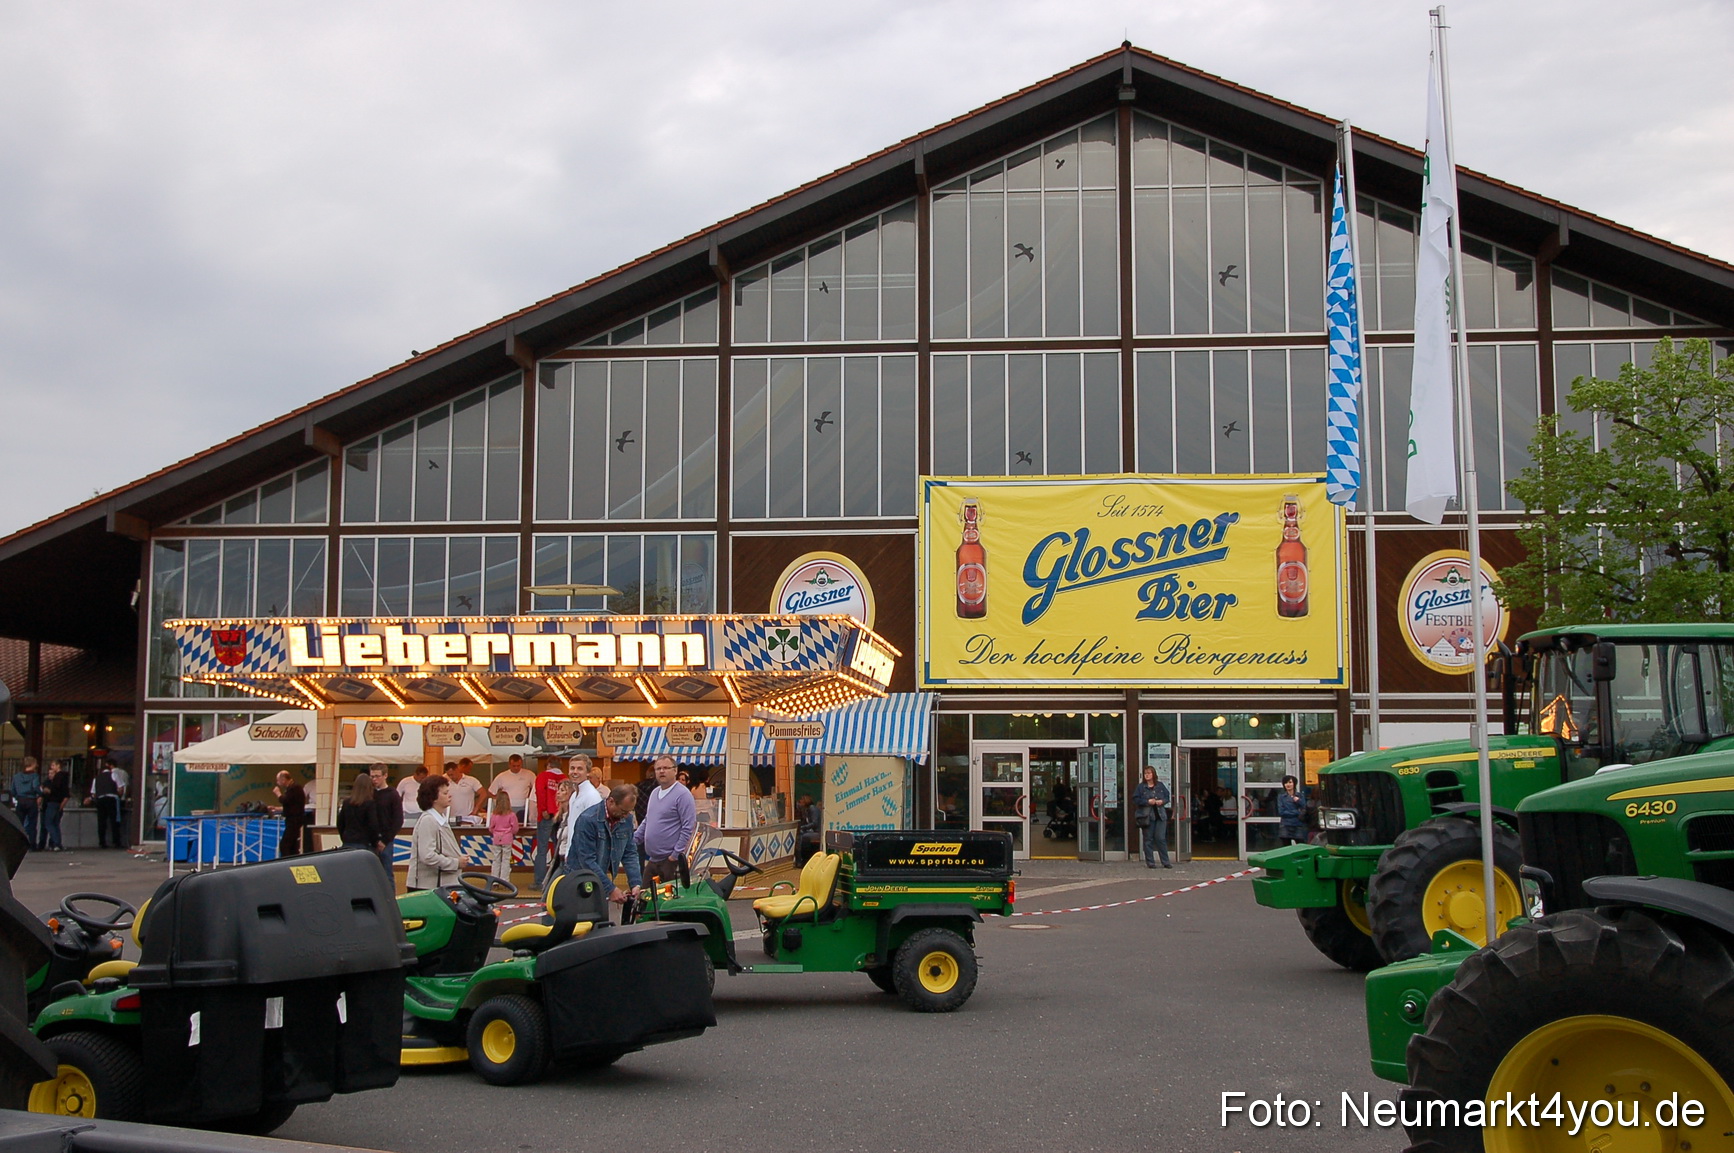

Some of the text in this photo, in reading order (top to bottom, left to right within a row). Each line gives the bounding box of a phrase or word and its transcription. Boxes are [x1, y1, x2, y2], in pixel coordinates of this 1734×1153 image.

[1097, 494, 1165, 518] Seit 1574
[1022, 511, 1241, 625] Glossner
[785, 585, 855, 614] Glossner
[1135, 572, 1239, 622] Bier
[1414, 585, 1488, 621] Glossnr
[1425, 613, 1484, 627] FESTBIE
[288, 624, 706, 667] Liebermann
[958, 633, 1309, 676] Der hochfeine Biergenuss
[1516, 750, 1542, 758] DEERE
[1398, 766, 1420, 776] 6830
[834, 781, 863, 803] Einmal
[845, 792, 871, 811] immer
[1625, 799, 1678, 818] 6430
[915, 844, 958, 854] Sperber
[888, 858, 985, 866] www.sperber.eu
